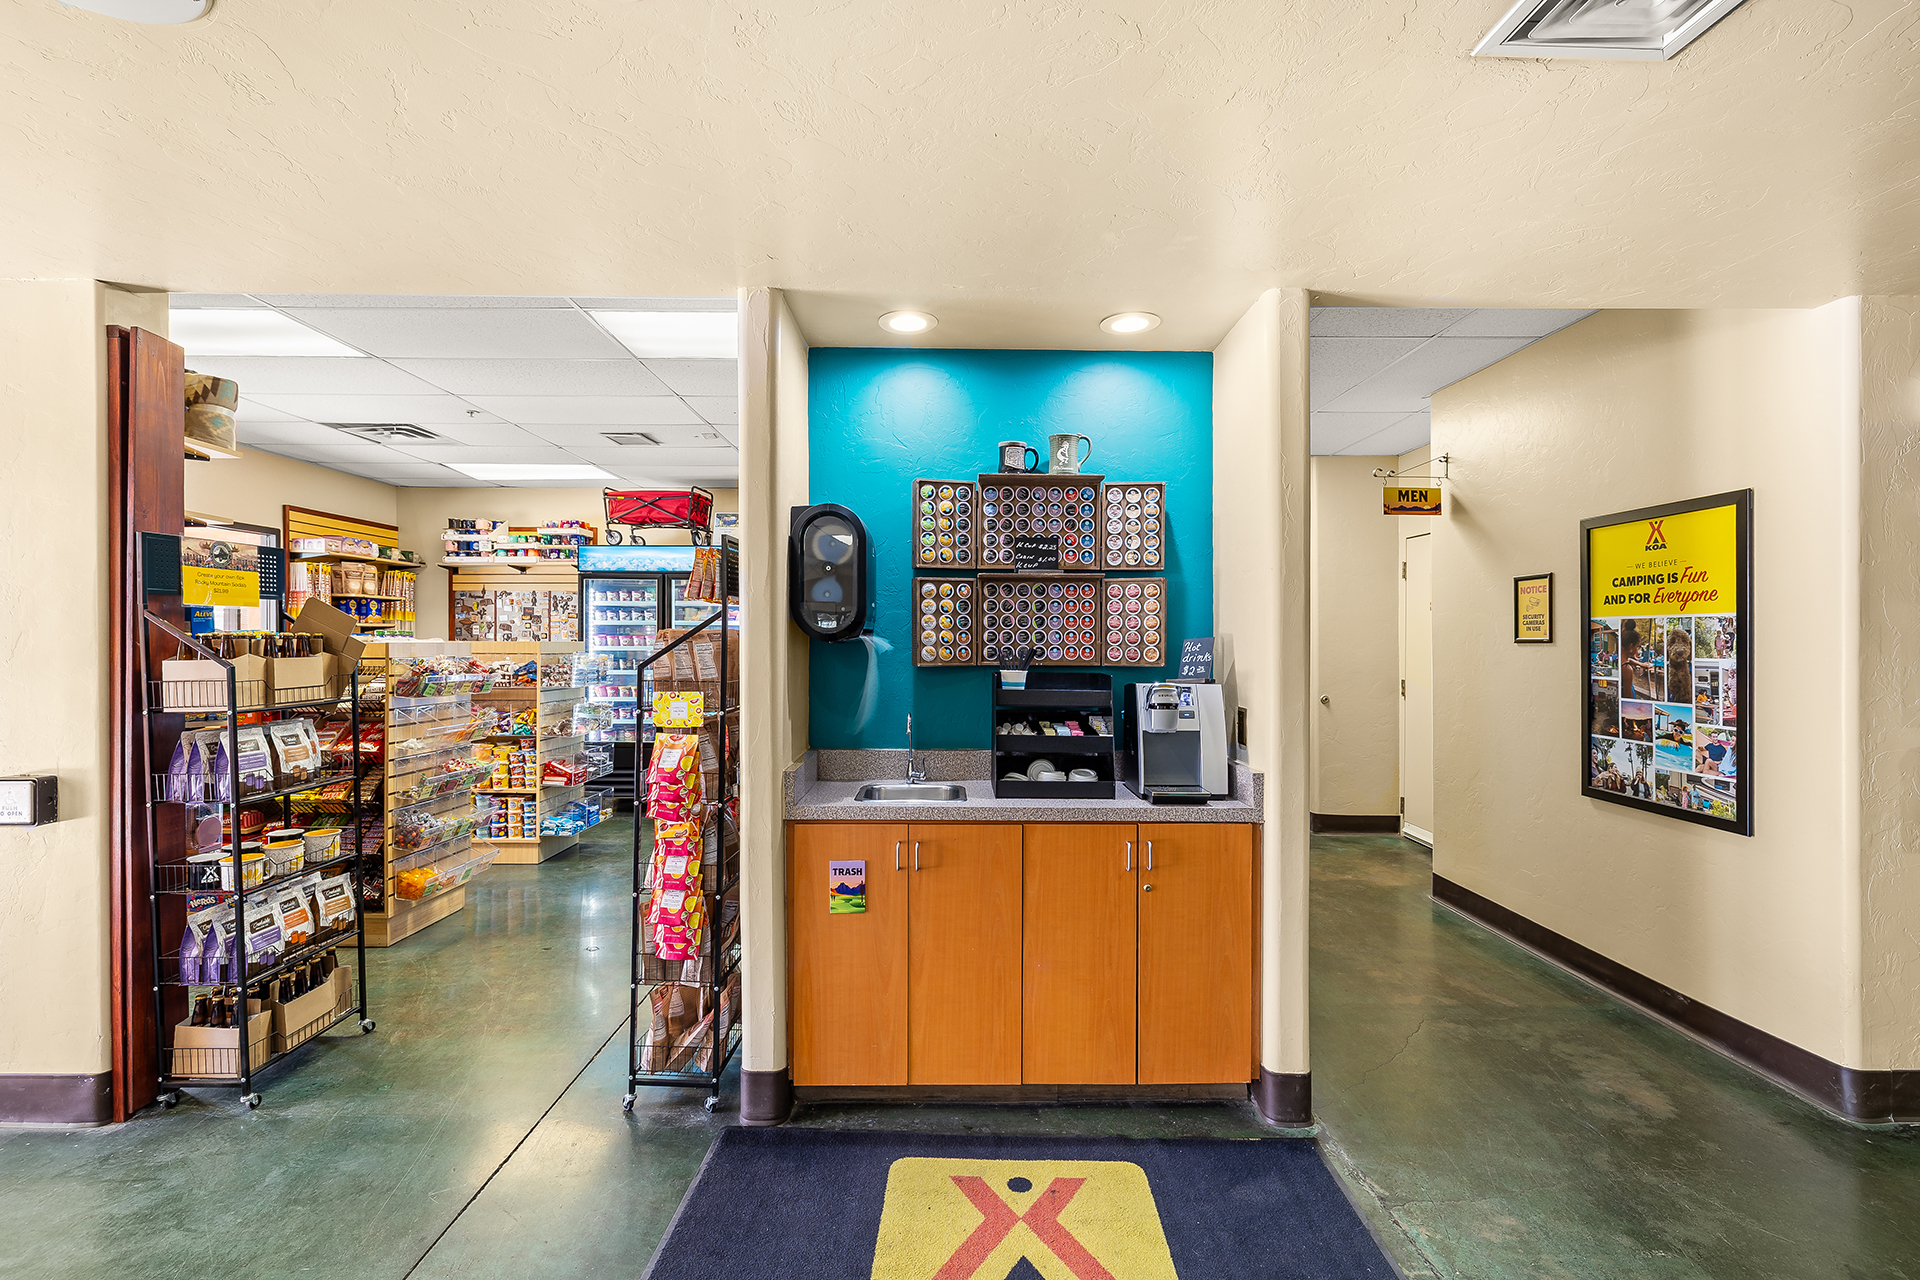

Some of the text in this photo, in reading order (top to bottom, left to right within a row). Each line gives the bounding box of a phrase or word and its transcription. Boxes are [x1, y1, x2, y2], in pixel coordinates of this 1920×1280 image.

[1398, 490, 1428, 503] MEN
[1645, 543, 1667, 551] KOA
[1648, 559, 1678, 568] BELIEVE
[1612, 566, 1709, 588] CAMPING IS Fun
[1520, 585, 1547, 594] NOTICE
[1604, 587, 1718, 612] AND FOR Everyone
[1184, 642, 1202, 652] Hot
[1182, 652, 1212, 662] drinks
[832, 868, 862, 876] TRASH
